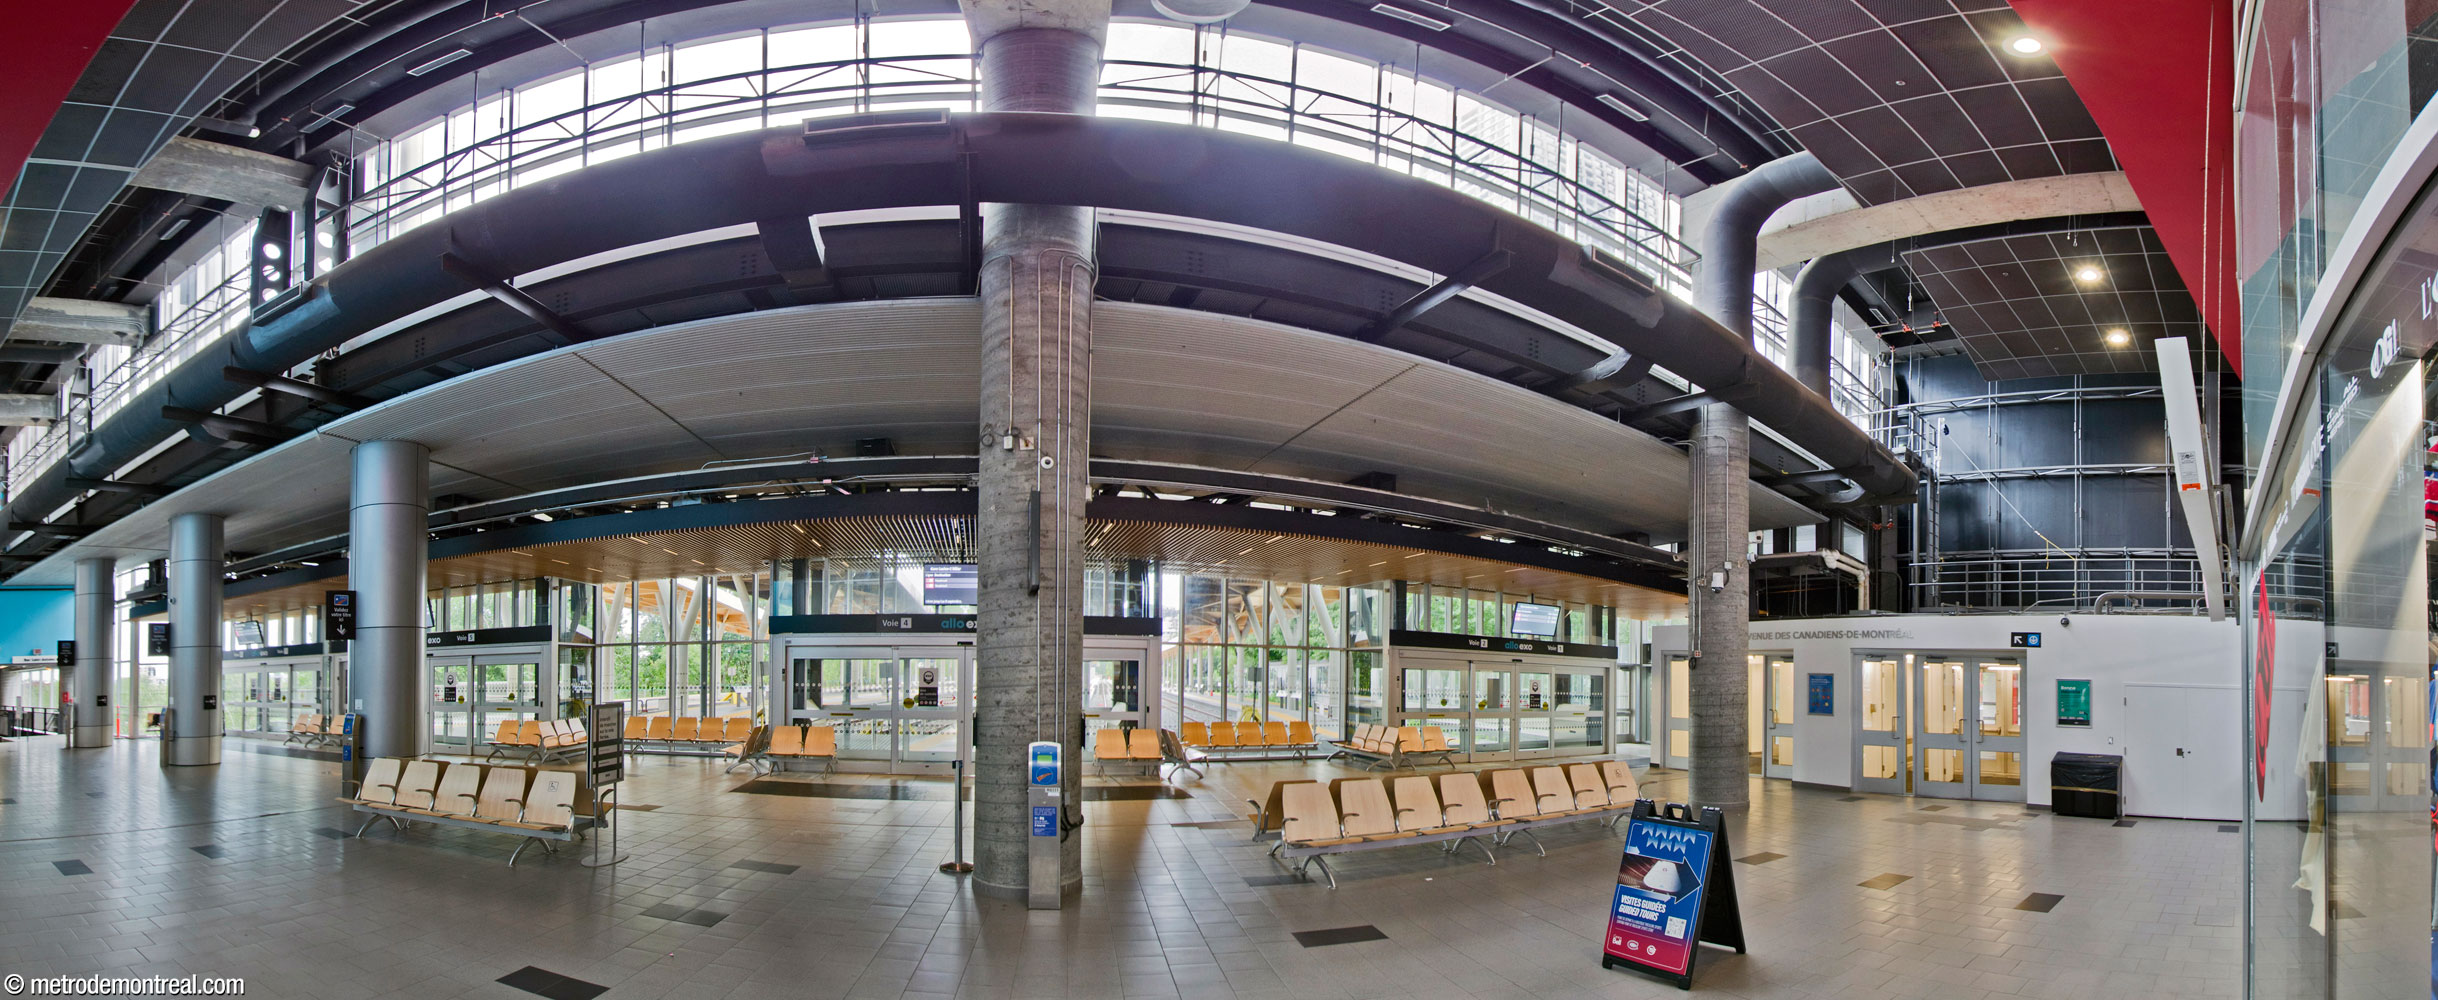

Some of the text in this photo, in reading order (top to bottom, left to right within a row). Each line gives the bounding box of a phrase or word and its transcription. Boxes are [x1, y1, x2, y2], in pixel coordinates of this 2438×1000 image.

[882, 619, 899, 627] Voie
[941, 618, 964, 629] allo
[1775, 632, 1791, 640] DES
[1505, 641, 1533, 651] allo exo
[1621, 894, 1667, 913] VISITES GUIDÉES
[1618, 904, 1659, 921] GUIDED TOURS
